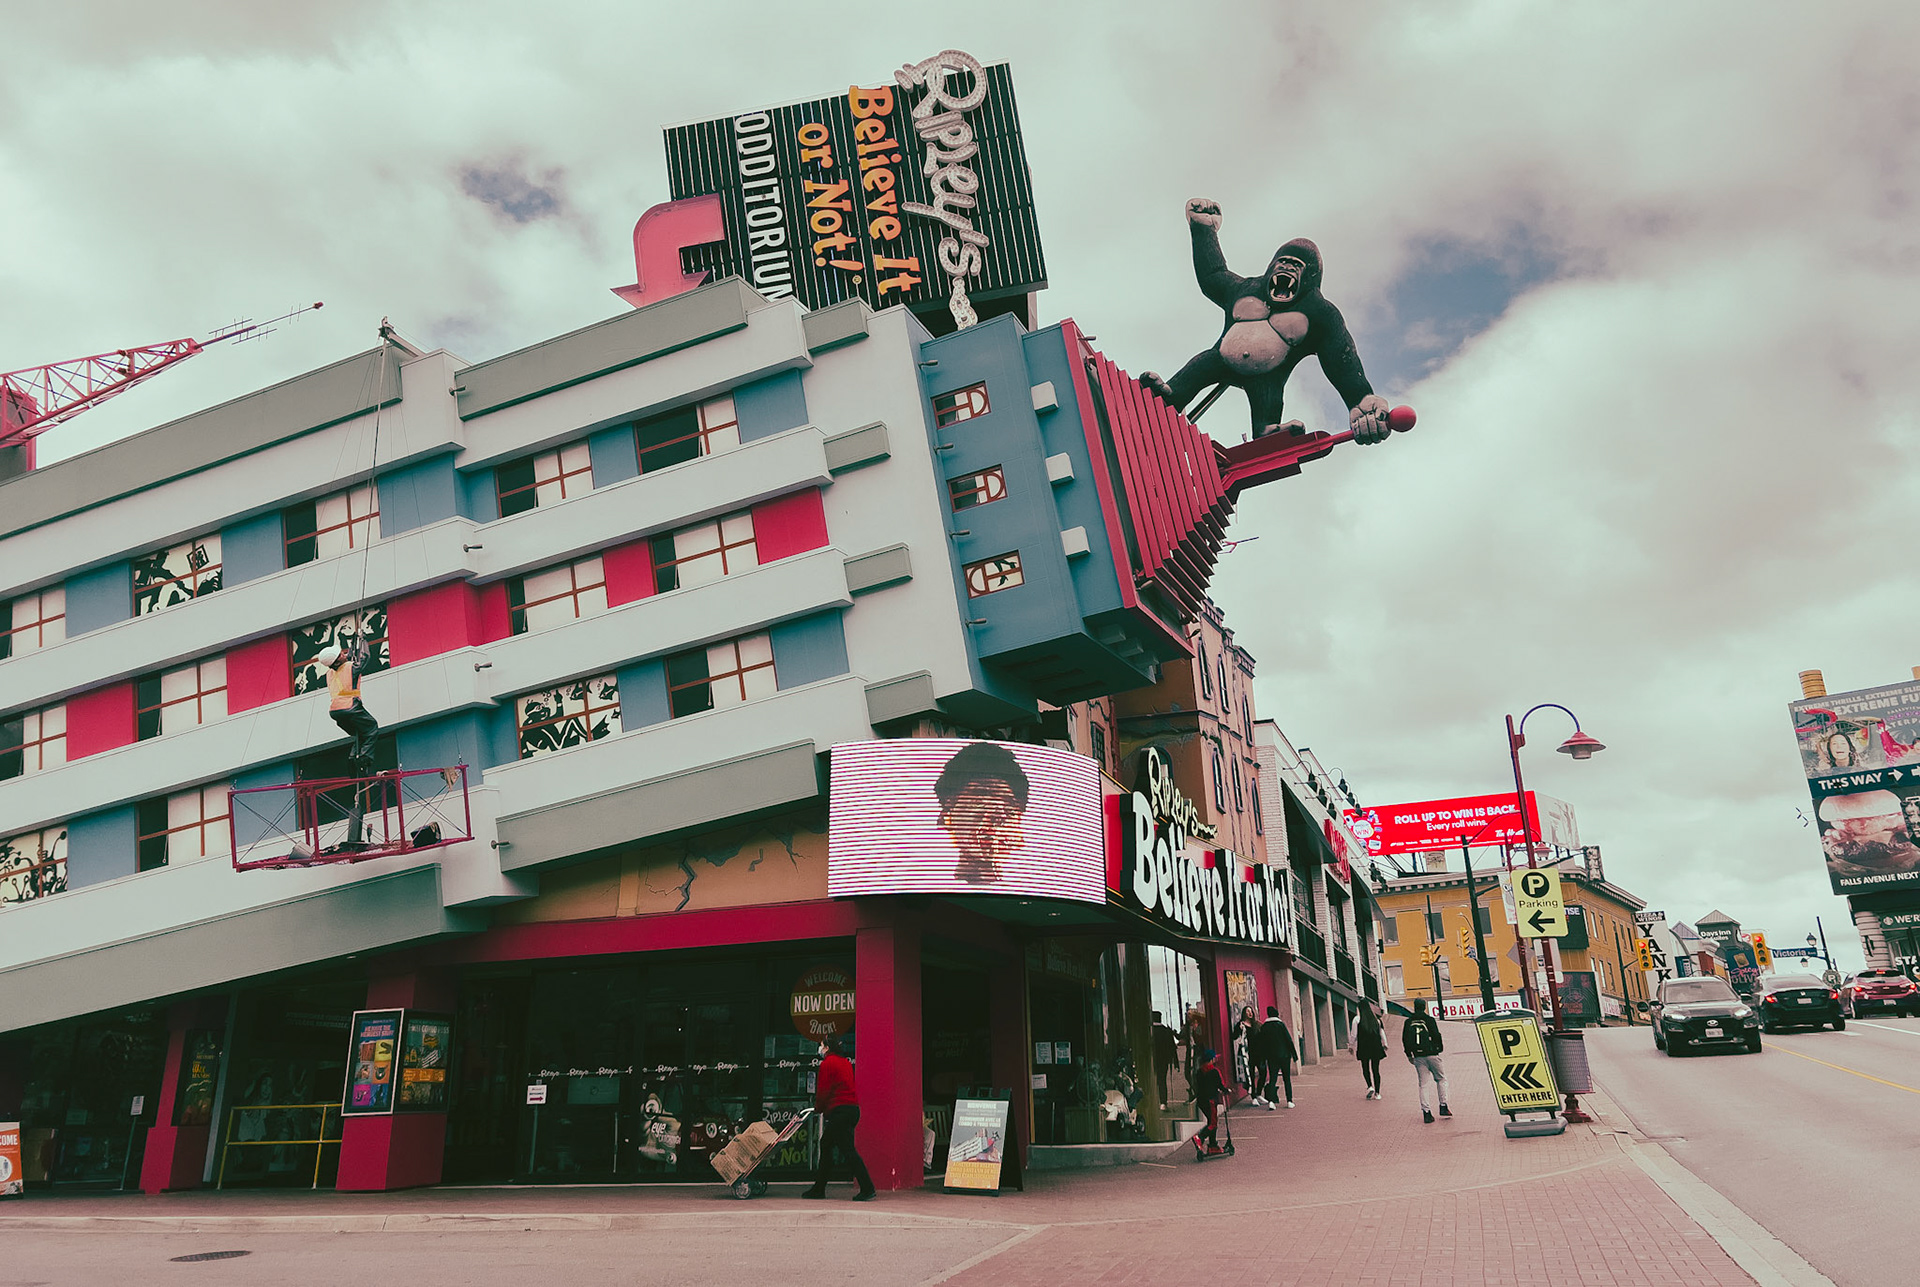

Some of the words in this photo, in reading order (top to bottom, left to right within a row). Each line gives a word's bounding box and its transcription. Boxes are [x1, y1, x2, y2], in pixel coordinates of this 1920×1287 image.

[798, 122, 834, 169] or
[849, 84, 902, 242] Believe
[894, 49, 990, 277] Ripley's
[804, 178, 865, 272] Not!
[874, 254, 922, 296] It
[1864, 688, 1903, 700] EXTREME
[1833, 696, 1899, 715] EXTREME
[1901, 692, 1920, 704] FU
[1850, 772, 1882, 786] WAY
[1148, 747, 1201, 849] Ripley's
[1394, 813, 1420, 825] ROLL
[1421, 812, 1436, 822] UP
[1436, 810, 1451, 820] TO
[1453, 808, 1473, 819] WIN
[1474, 807, 1486, 817] IS
[1426, 822, 1450, 831] Every
[1452, 819, 1465, 828] roll
[1133, 791, 1226, 936] Believe
[1225, 849, 1246, 939] It
[1246, 881, 1265, 942] or
[1527, 875, 1545, 895] P
[1840, 877, 1862, 887] FALLS
[1863, 873, 1897, 884] AVENUE
[1897, 871, 1919, 881] NEXT
[1519, 900, 1558, 909] Parking
[1700, 930, 1718, 938] Days
[1773, 948, 1806, 957] Victoria
[804, 971, 847, 987] WELCOME
[794, 994, 821, 1012] NOW
[825, 993, 855, 1011] OPEN
[1480, 1001, 1519, 1014] CGAR
[1498, 1029, 1521, 1055] P
[1501, 1093, 1529, 1104] ENTER
[1529, 1091, 1553, 1101] HERE
